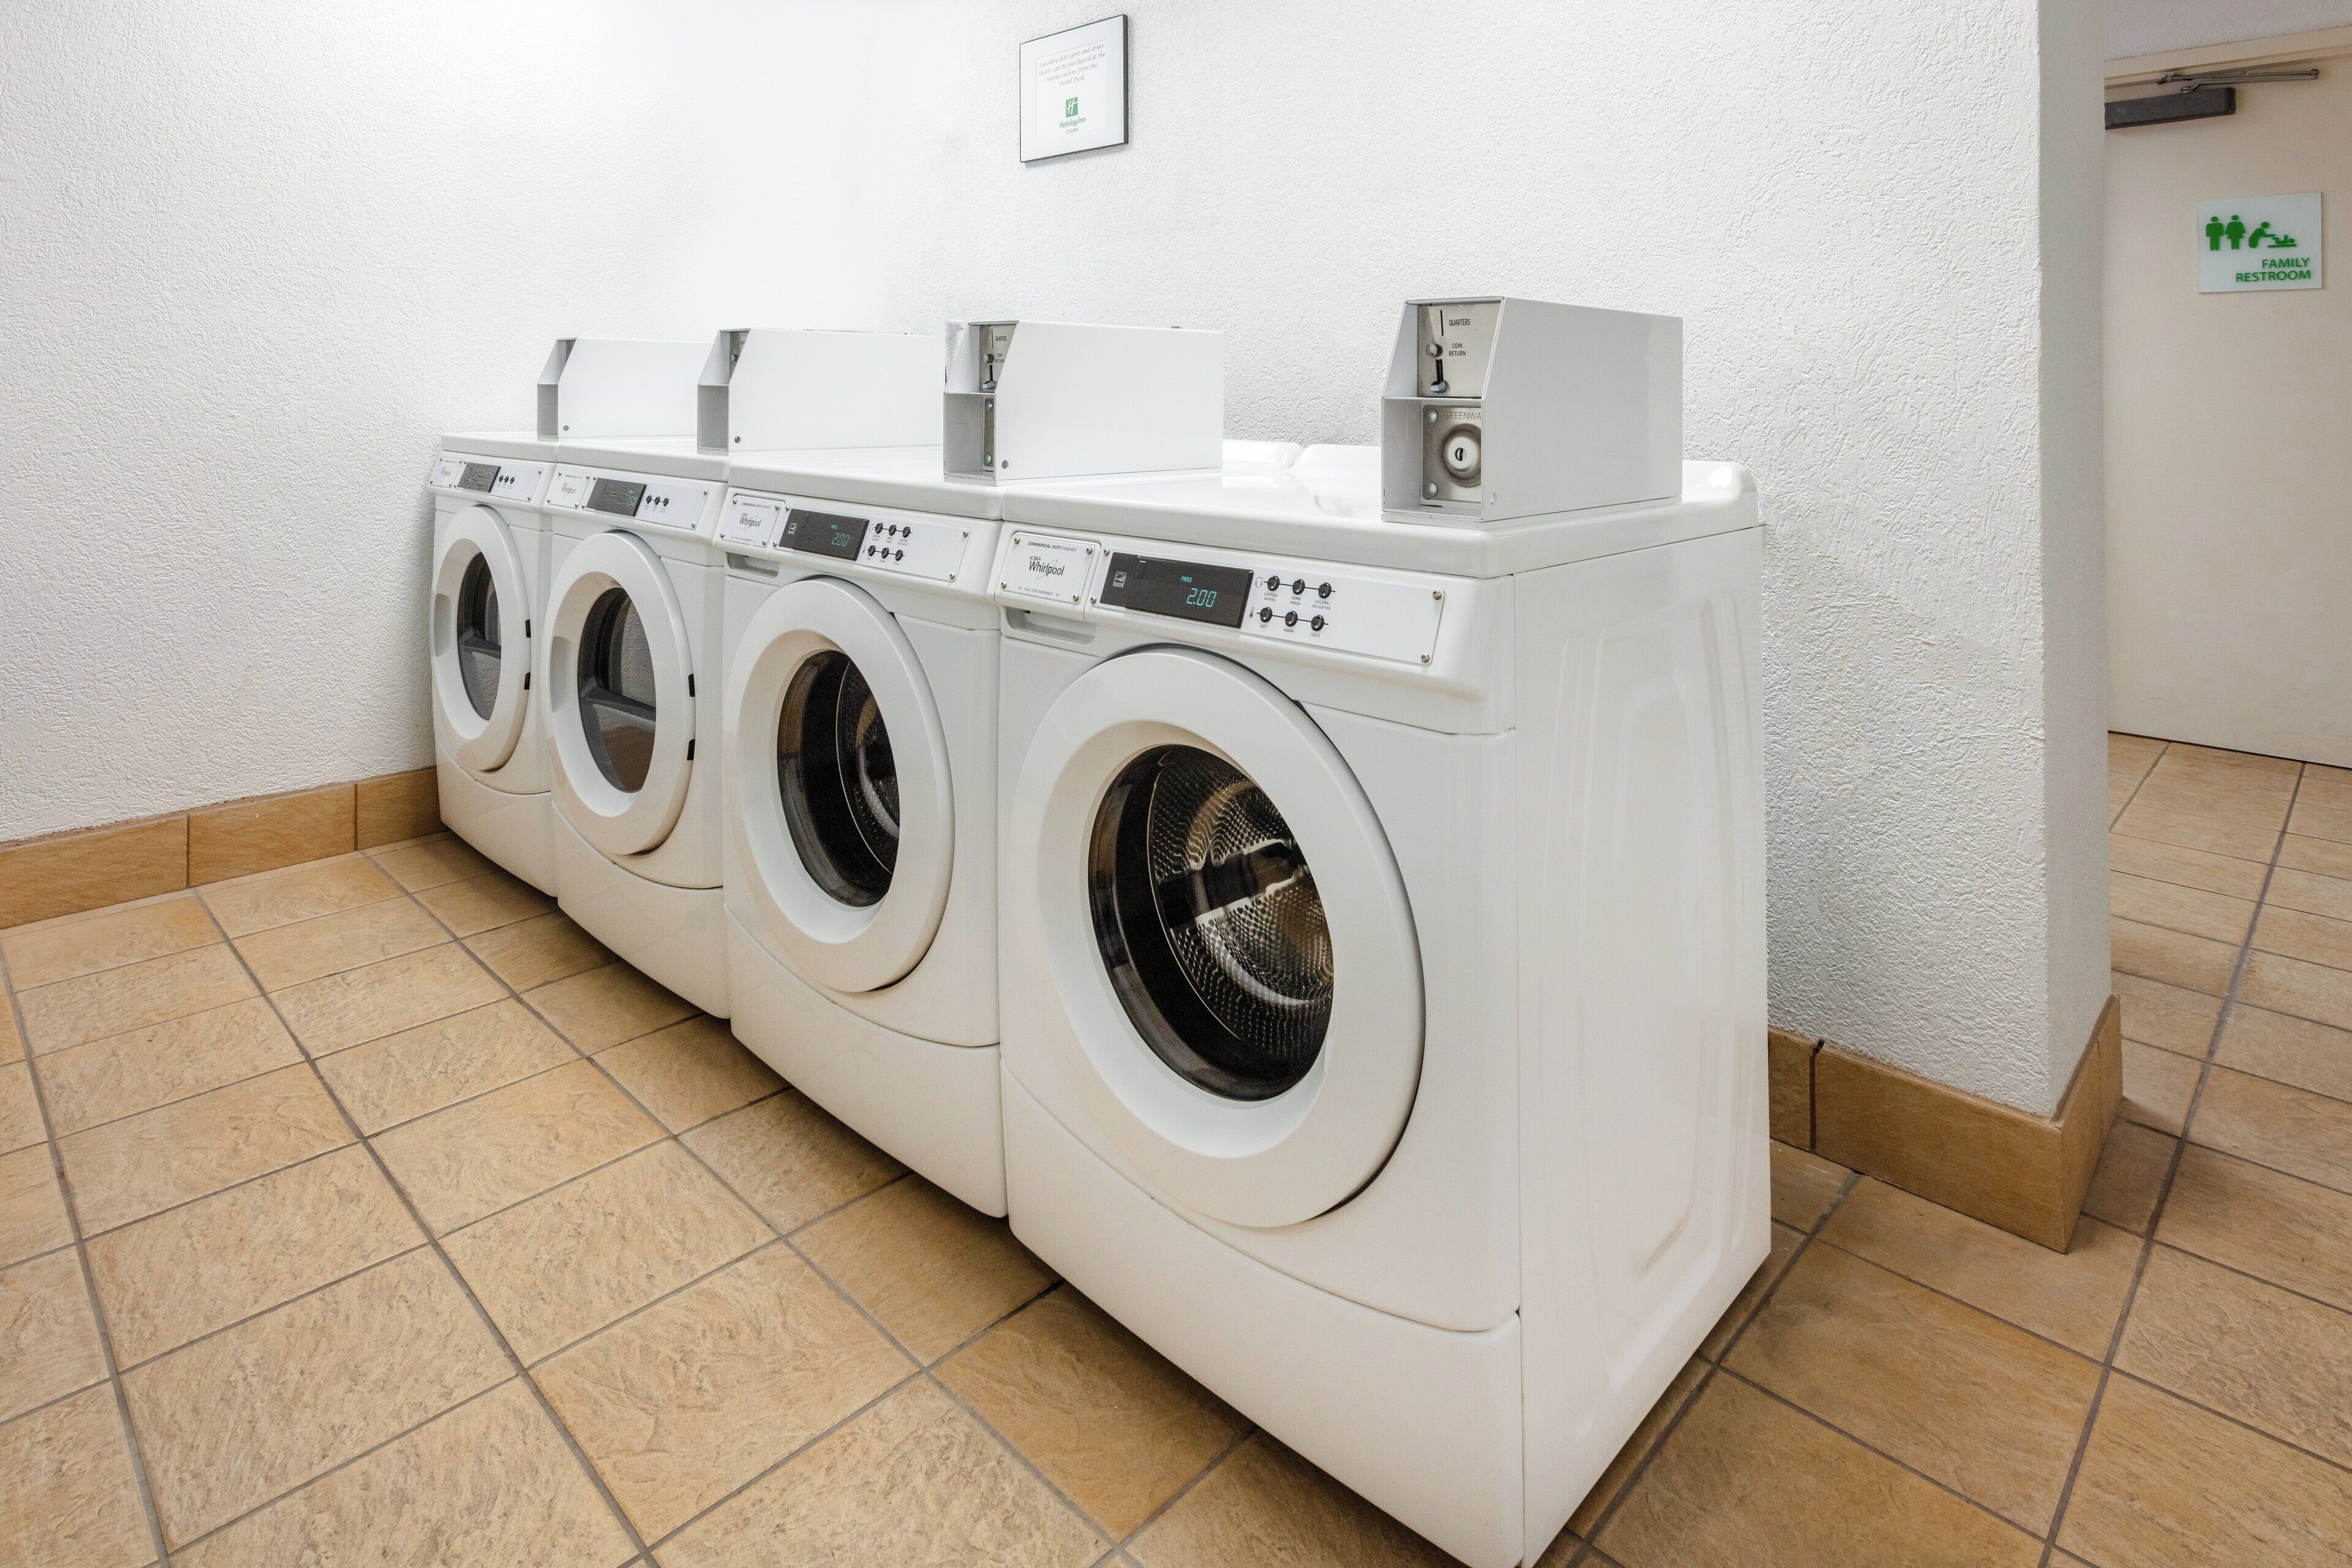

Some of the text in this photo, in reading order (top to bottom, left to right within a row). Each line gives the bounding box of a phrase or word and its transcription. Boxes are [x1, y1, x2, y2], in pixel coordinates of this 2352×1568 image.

[1039, 43, 1105, 68] Laundry detergent and dryer
[1039, 67, 1052, 76] sheets
[1068, 55, 1090, 69] purchased
[1046, 74, 1062, 82] market
[1078, 66, 1089, 75] from
[1074, 74, 1085, 83] Desk
[1060, 119, 1078, 129] Holiday
[2262, 257, 2310, 268] FAMILY
[2236, 270, 2311, 282] RESTROOM
[740, 516, 762, 528] Whirlpool
[831, 533, 851, 547] 2.00
[1029, 560, 1065, 576] Whirlpool
[1186, 587, 1217, 607] 2.00
